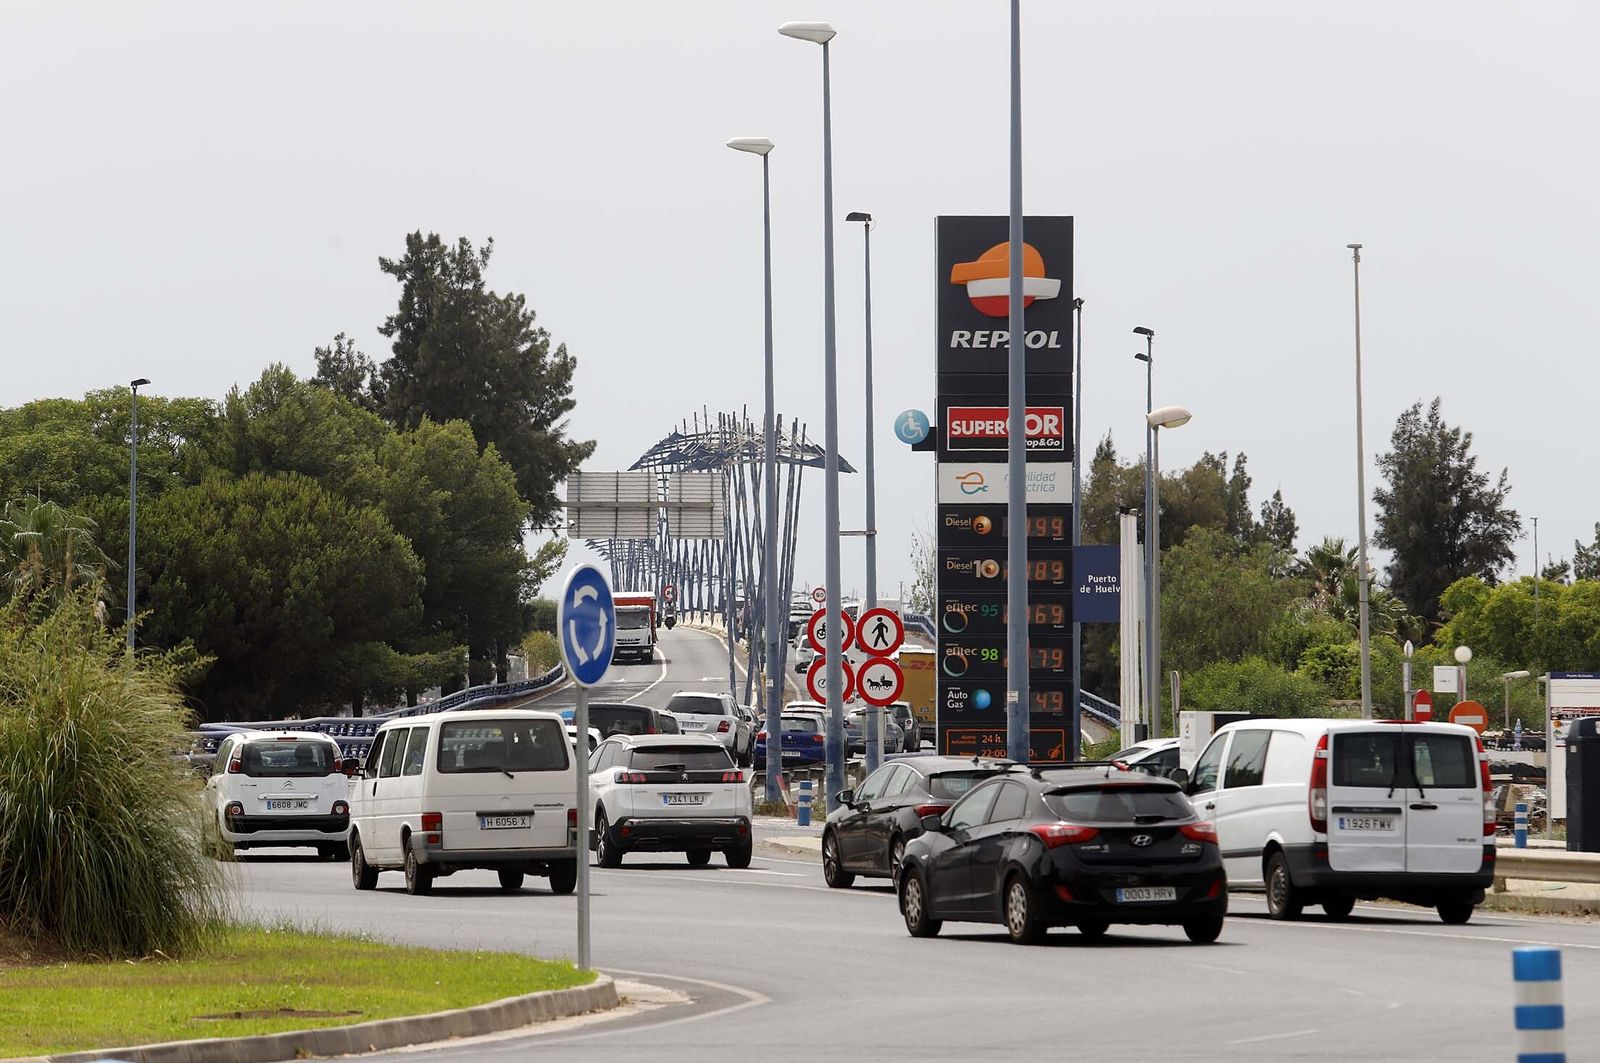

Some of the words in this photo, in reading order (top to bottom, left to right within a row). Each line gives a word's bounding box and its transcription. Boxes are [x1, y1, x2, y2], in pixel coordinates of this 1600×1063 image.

[950, 330, 1061, 349] REPOL
[951, 413, 1060, 436] SUPEROR
[1008, 438, 1060, 448] op&Go
[1004, 471, 1056, 482] ilidad
[945, 517, 971, 526] Diesel
[946, 560, 973, 570] Diesel
[1088, 574, 1117, 583] Puerto
[1080, 585, 1091, 593] de
[1095, 585, 1120, 593] Huelv
[946, 603, 978, 612] efitec
[981, 604, 998, 616] 95
[946, 647, 978, 656] efitec
[981, 648, 998, 661] 98
[947, 690, 968, 699] Auto
[947, 699, 964, 709] Gas
[981, 734, 993, 743] 24
[668, 795, 687, 803] 7341
[689, 795, 704, 803] LRJ
[486, 819, 492, 827] H
[496, 818, 517, 826] 6056
[521, 818, 526, 826] X
[1346, 819, 1370, 829] 1926
[1373, 819, 1392, 829] FMV
[1125, 889, 1151, 899] 0003
[1154, 888, 1174, 898] HRV
